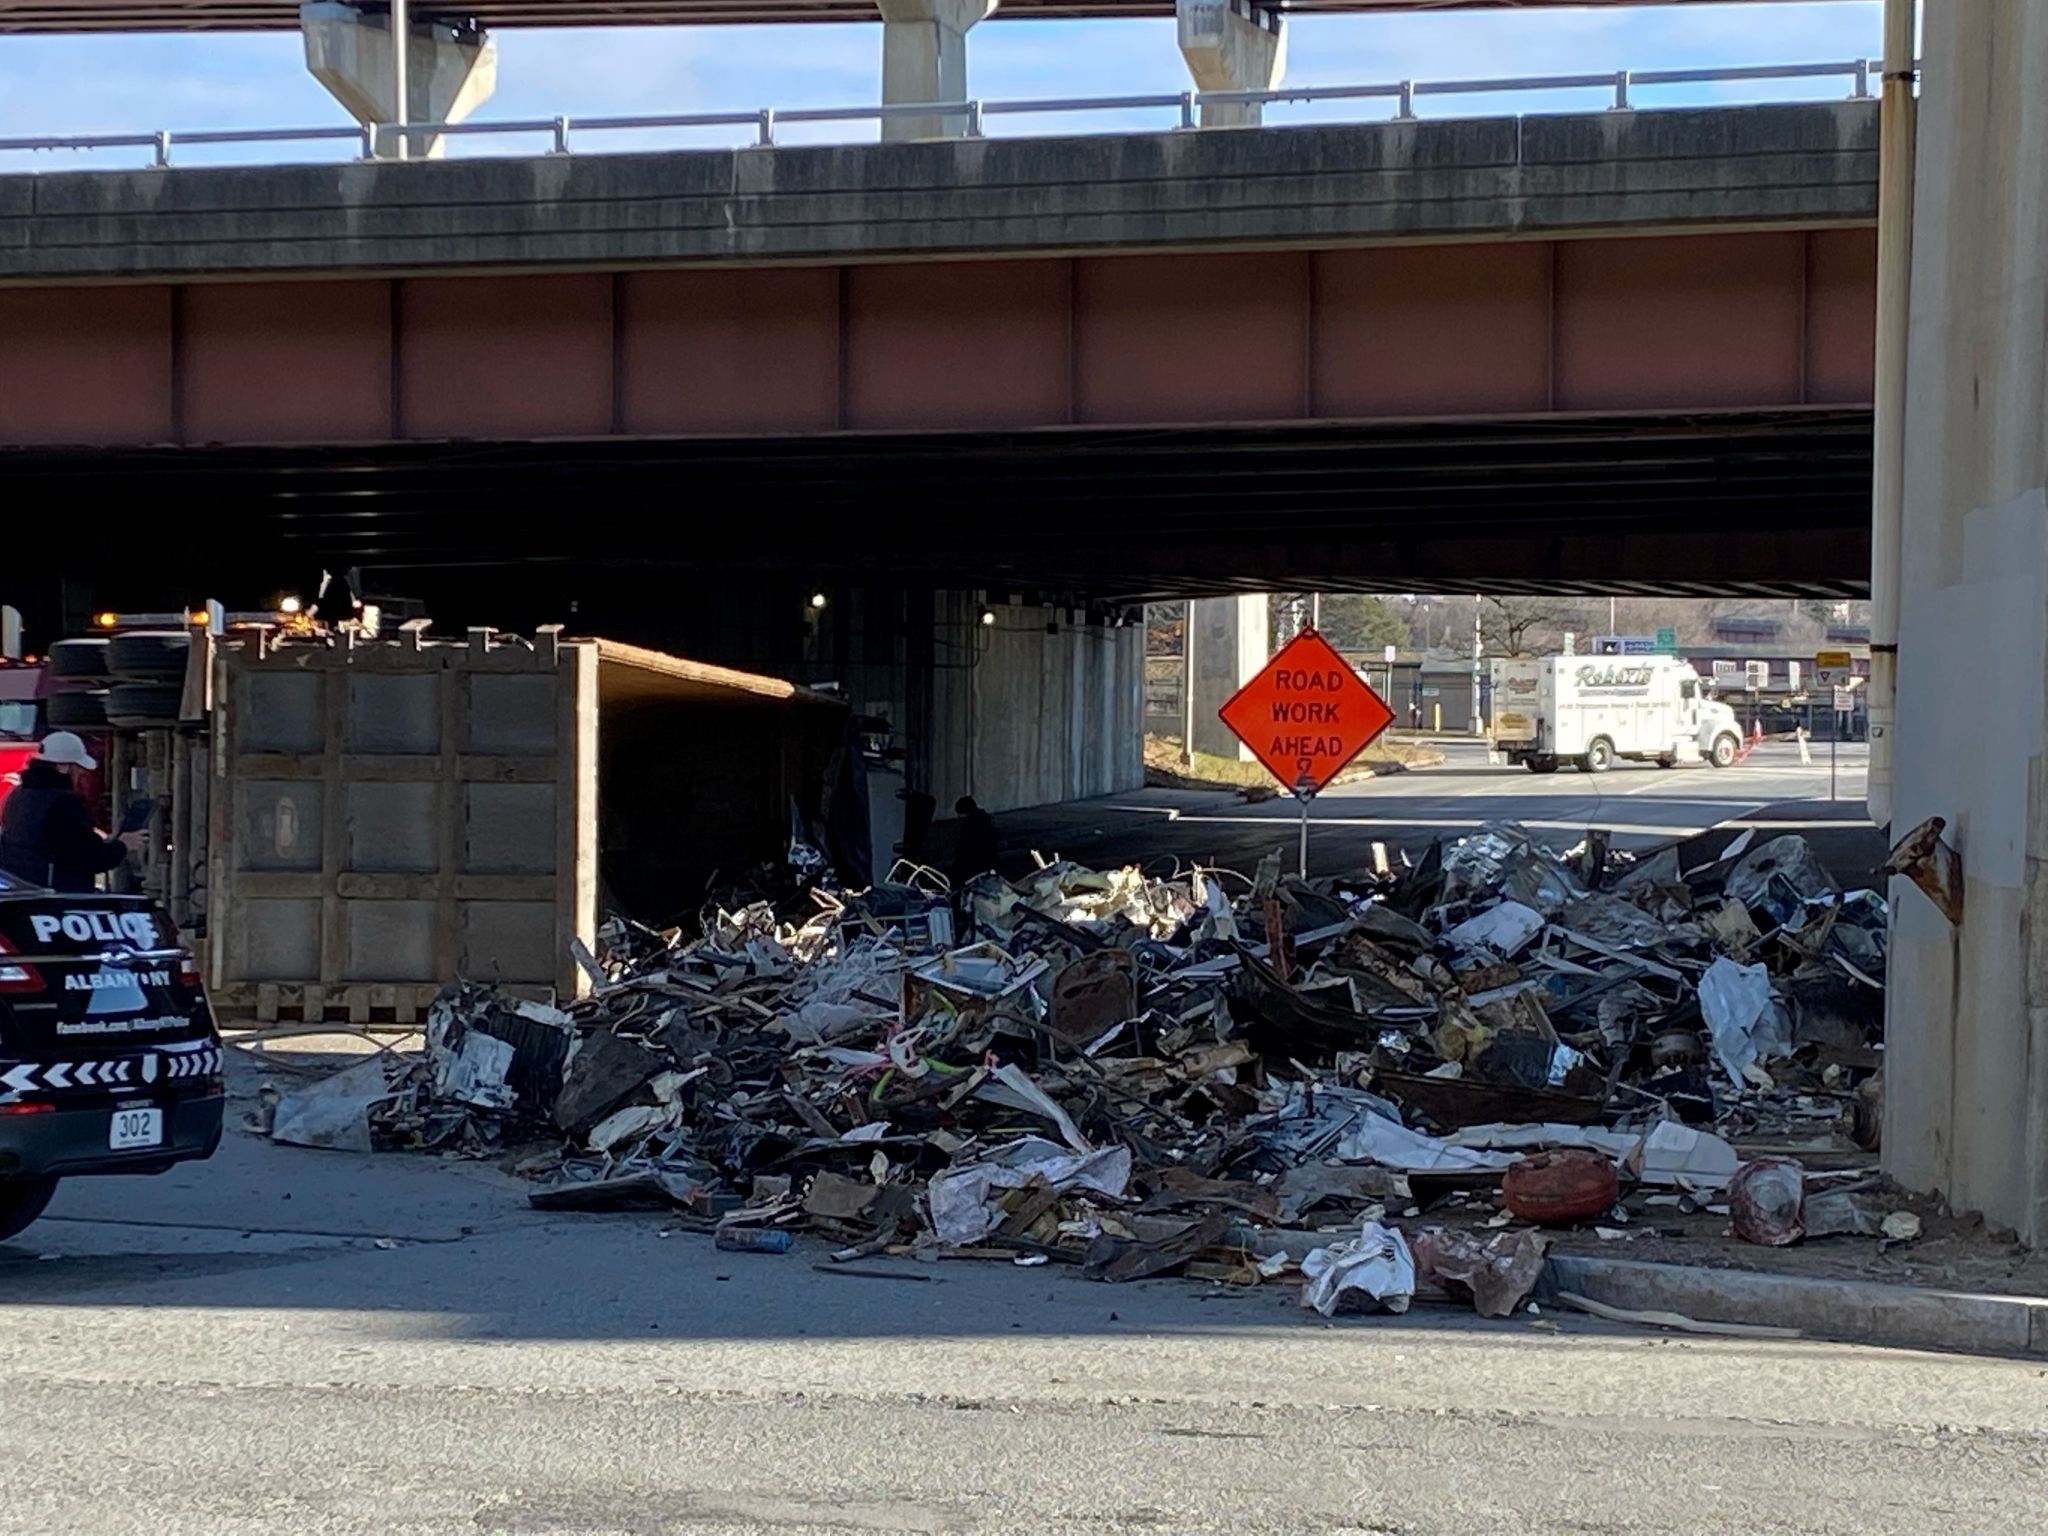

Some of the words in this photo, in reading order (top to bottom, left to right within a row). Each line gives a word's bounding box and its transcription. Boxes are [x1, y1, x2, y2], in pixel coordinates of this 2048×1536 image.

[1275, 669, 1344, 692] ROAD
[1272, 702, 1340, 723] WORK
[1270, 736, 1343, 757] AHEAD
[30, 912, 160, 943] POLICE
[64, 972, 138, 990] ALBANY
[149, 970, 171, 987] NY
[119, 1112, 151, 1139] 302
